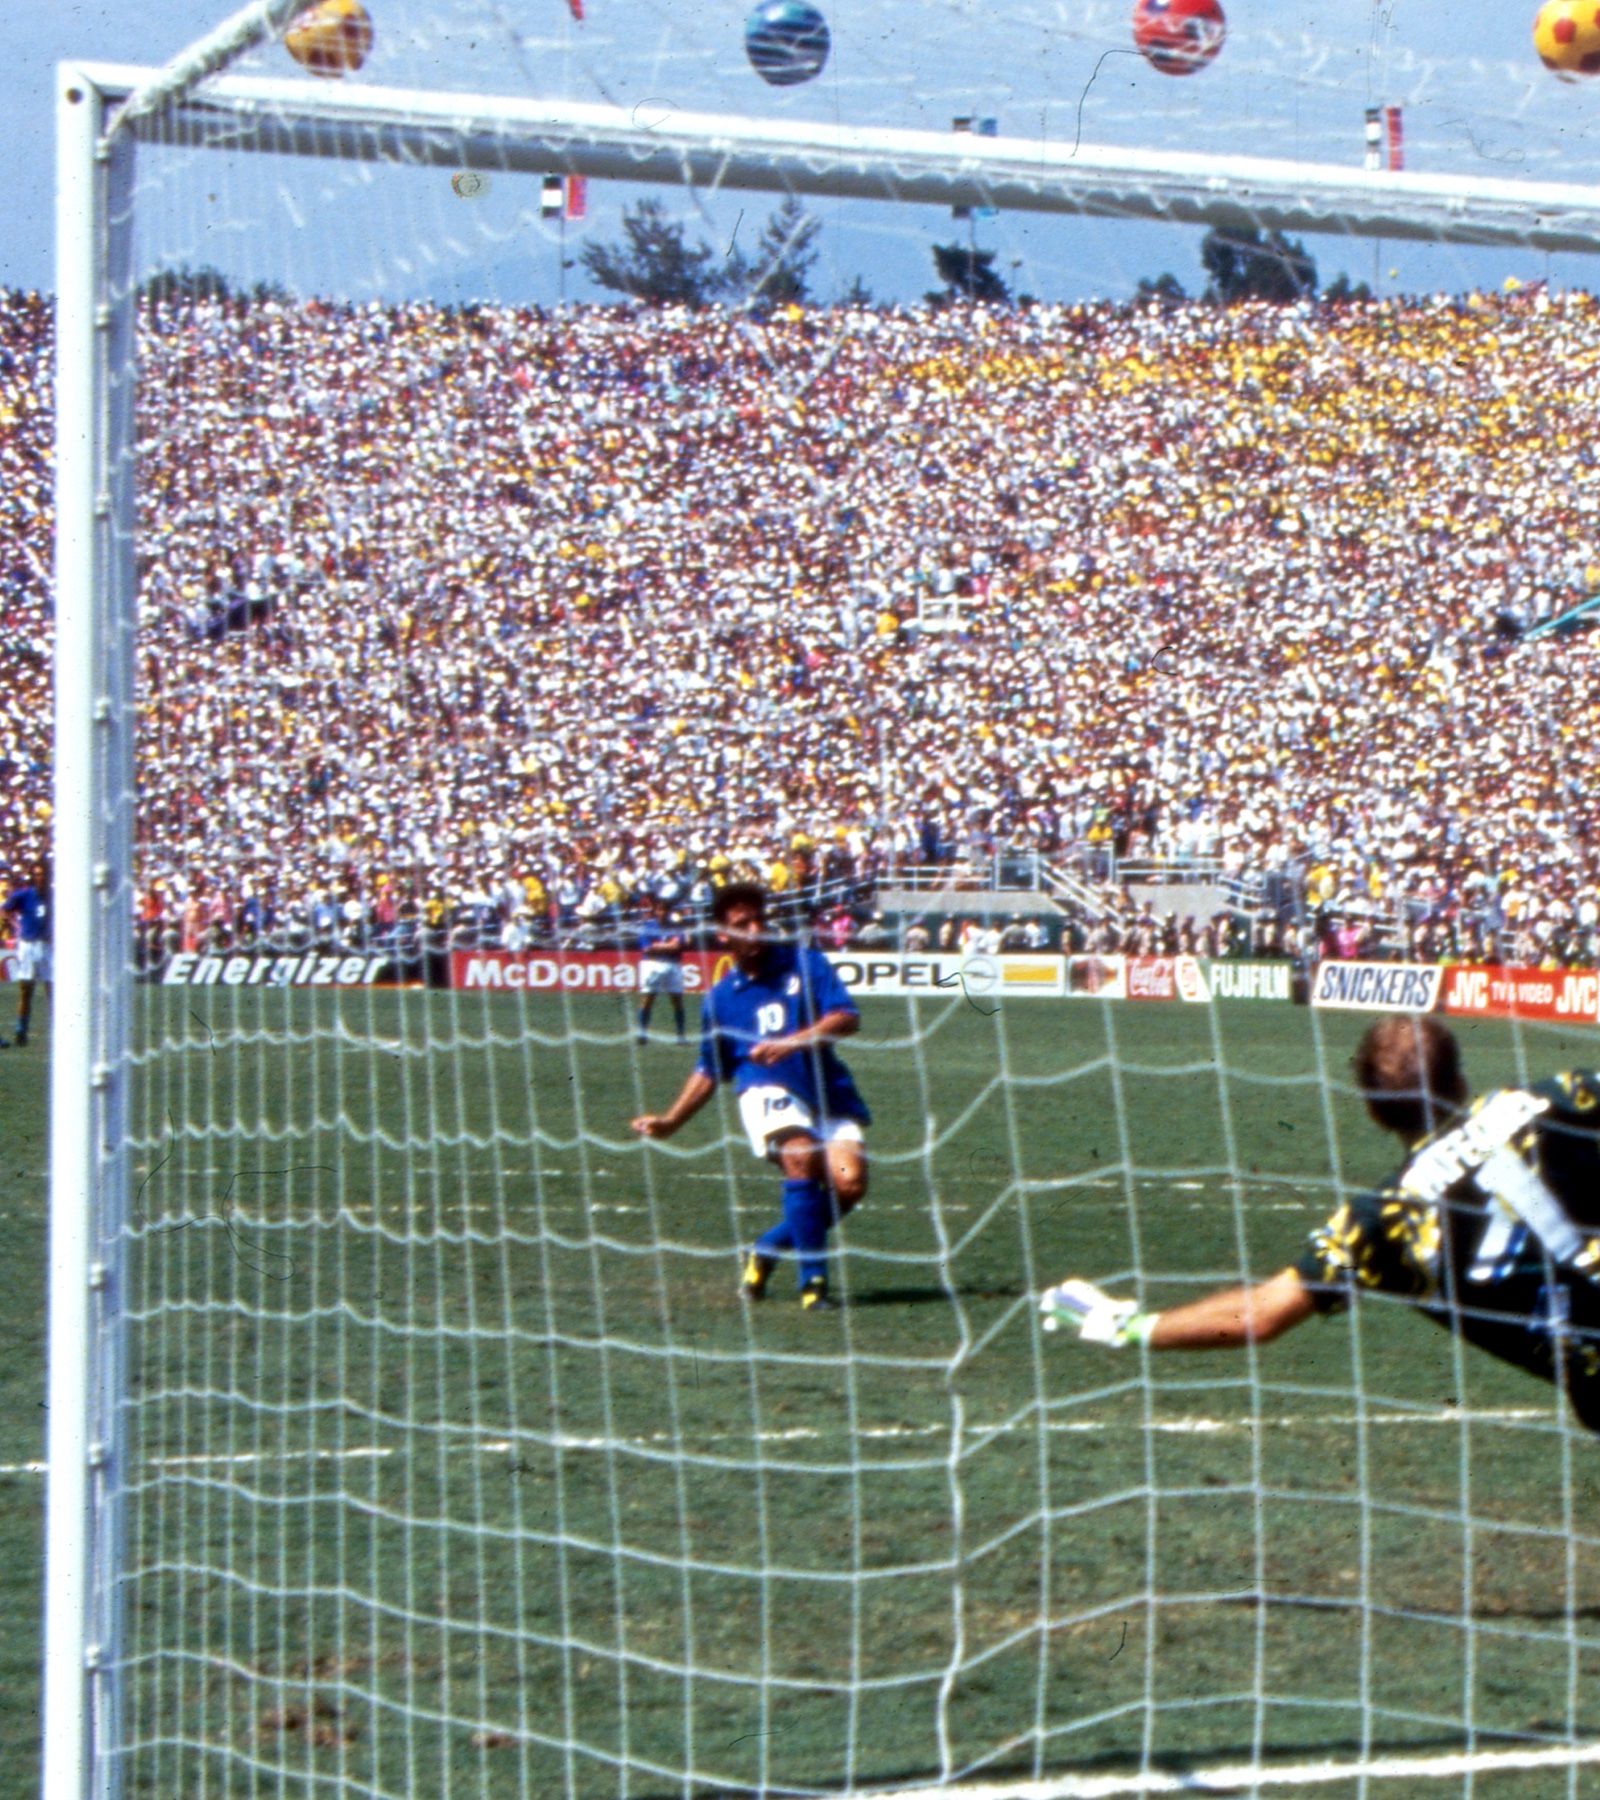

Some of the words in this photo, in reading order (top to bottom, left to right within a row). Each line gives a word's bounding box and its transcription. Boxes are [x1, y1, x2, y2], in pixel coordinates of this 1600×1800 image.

[162, 951, 388, 986] Energizer
[831, 961, 941, 987] OPEL
[1211, 963, 1289, 999] FUJIFILM
[1319, 965, 1436, 1007] SNICKERS
[1448, 971, 1489, 1009] JVC
[1518, 983, 1554, 1005] VIDEO
[1556, 976, 1598, 1014] JVC
[757, 1002, 784, 1036] 10
